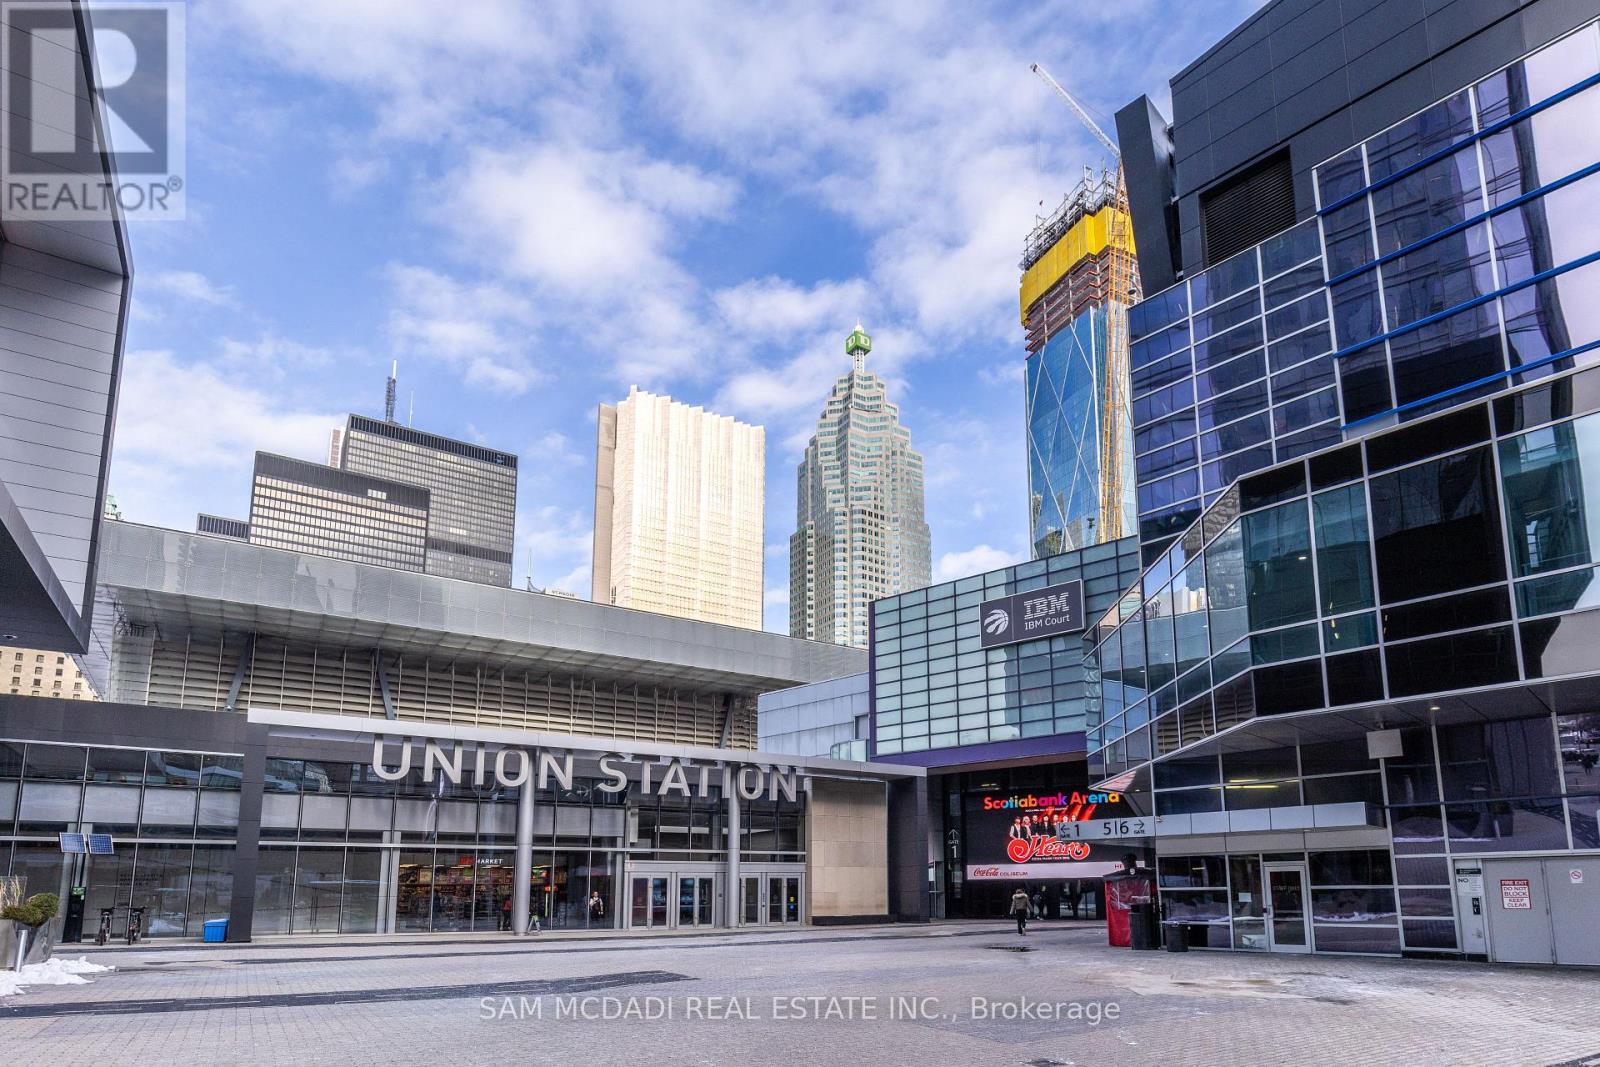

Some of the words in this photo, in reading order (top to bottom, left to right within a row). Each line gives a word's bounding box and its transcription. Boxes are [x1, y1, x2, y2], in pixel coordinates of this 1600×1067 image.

[1023, 592, 1070, 620] IBM
[1024, 619, 1043, 630] IBM
[1045, 614, 1070, 626] Court
[373, 735, 574, 790] UNION
[599, 753, 797, 802] STATION
[983, 792, 1068, 810] Scotiabank
[1070, 791, 1120, 805] Arena
[1074, 824, 1080, 837] 1
[951, 845, 957, 858] 1
